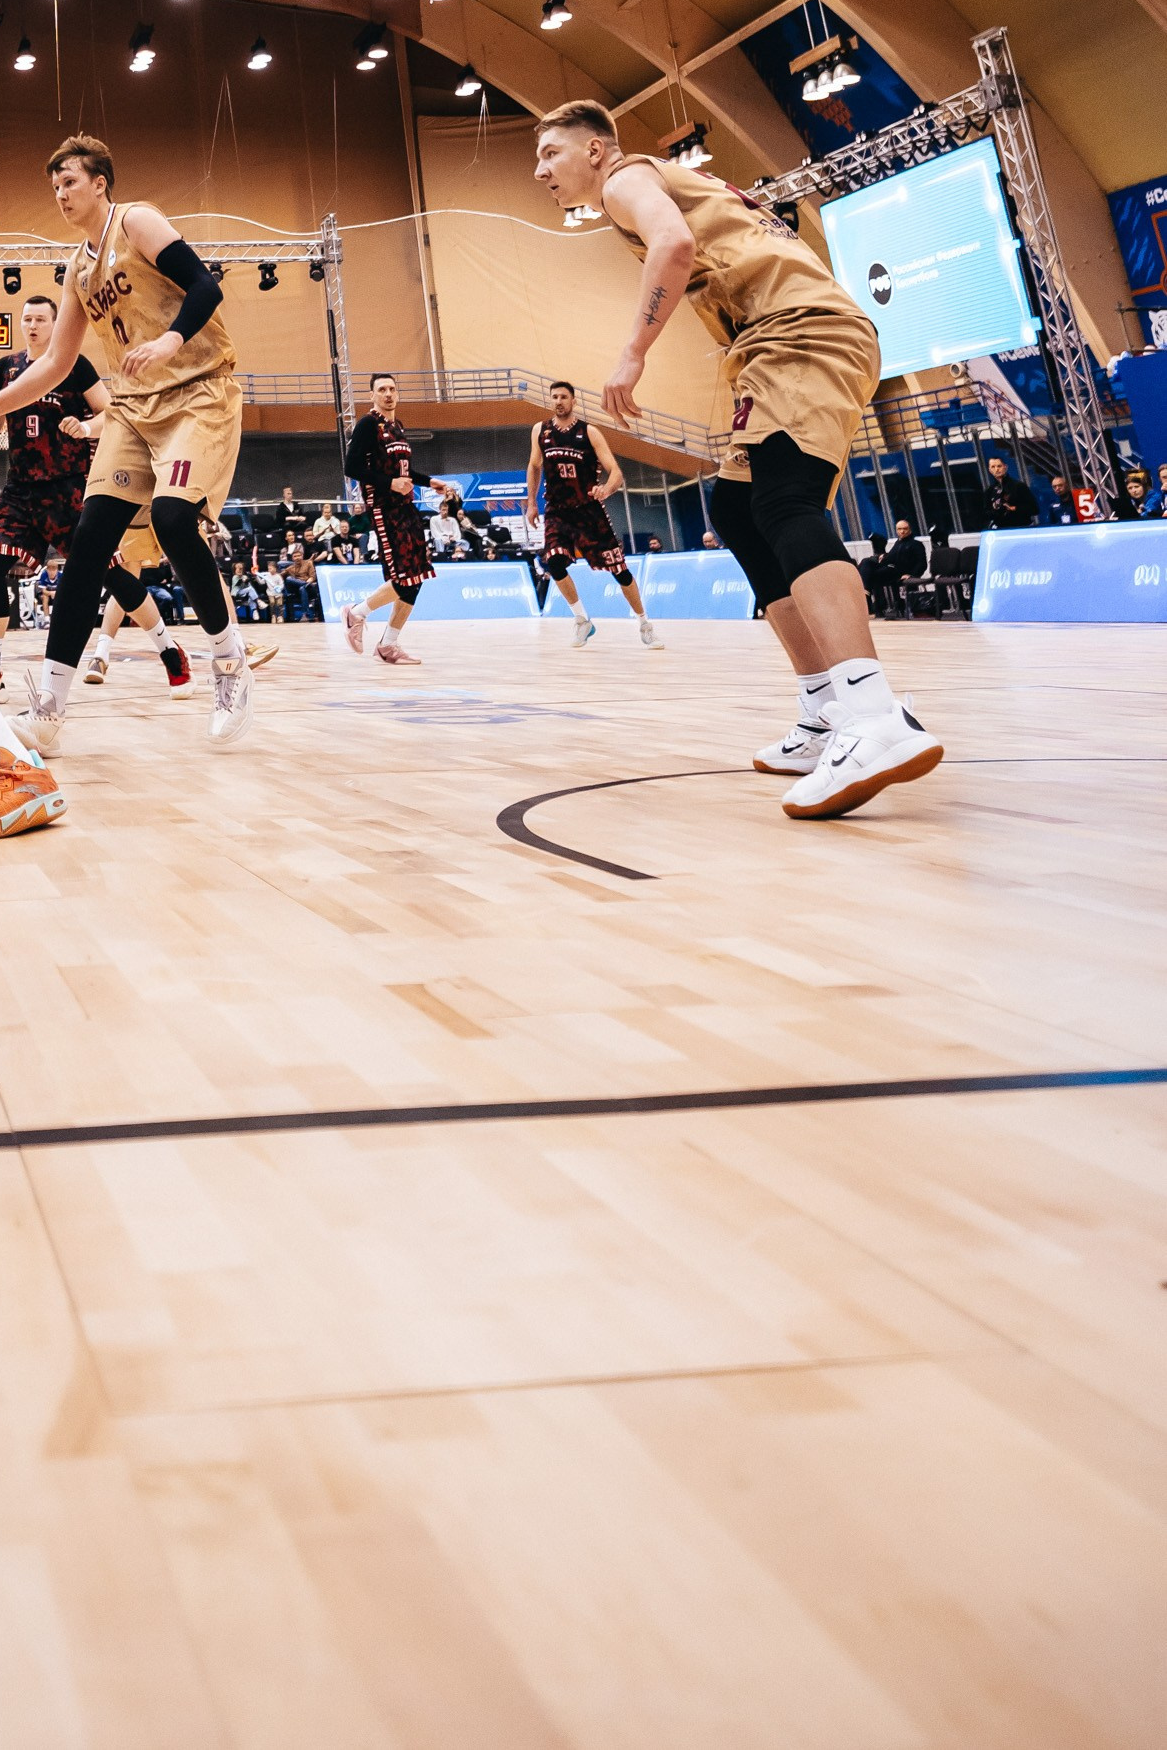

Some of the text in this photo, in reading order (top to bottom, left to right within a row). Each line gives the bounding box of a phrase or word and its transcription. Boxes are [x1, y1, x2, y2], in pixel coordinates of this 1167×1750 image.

[25, 414, 40, 438] 9
[169, 460, 192, 487] 11
[398, 459, 410, 477] 12
[558, 463, 577, 478] 33
[1078, 494, 1095, 517] 5
[602, 547, 624, 565] 33
